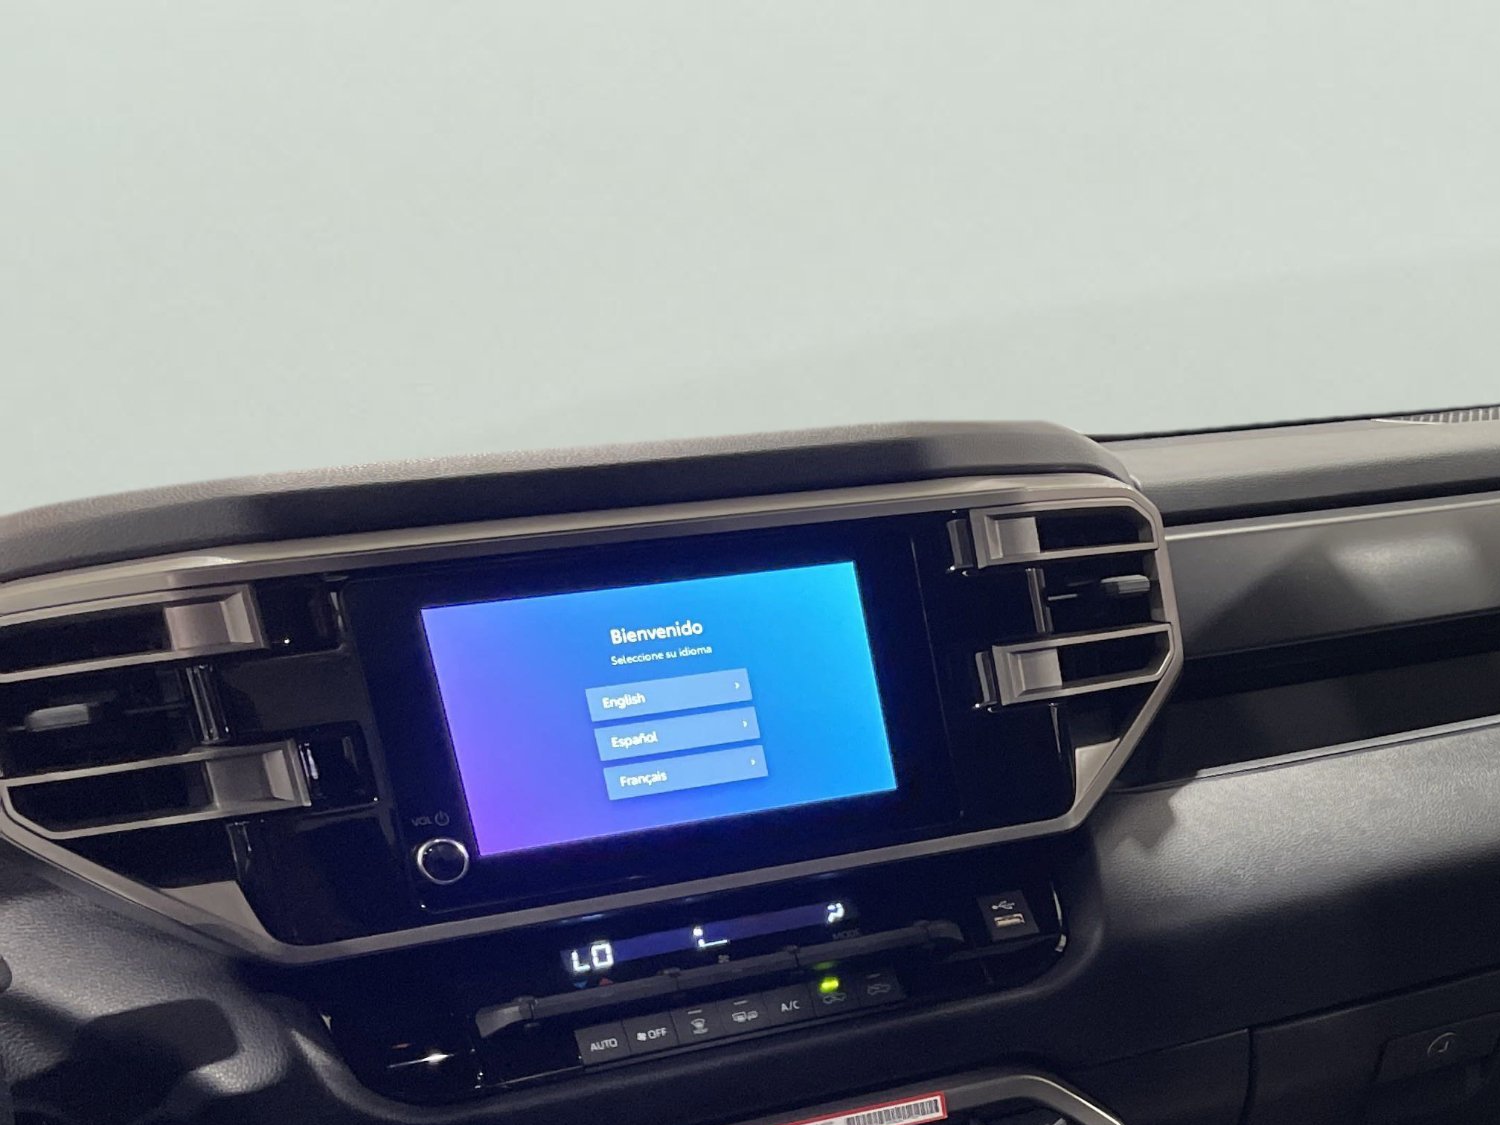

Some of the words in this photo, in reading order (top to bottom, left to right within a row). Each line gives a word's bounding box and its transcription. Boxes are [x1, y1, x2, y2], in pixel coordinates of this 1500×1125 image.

[610, 620, 703, 645] Bienvenido
[610, 651, 664, 666] Seleccione
[665, 650, 677, 659] su
[678, 645, 713, 658] idioma
[602, 692, 646, 709] English
[611, 731, 658, 749] Español
[620, 771, 667, 787] Français
[780, 1000, 801, 1013] A/C
[648, 1027, 668, 1040] OFF
[590, 1038, 618, 1052] AUTO
